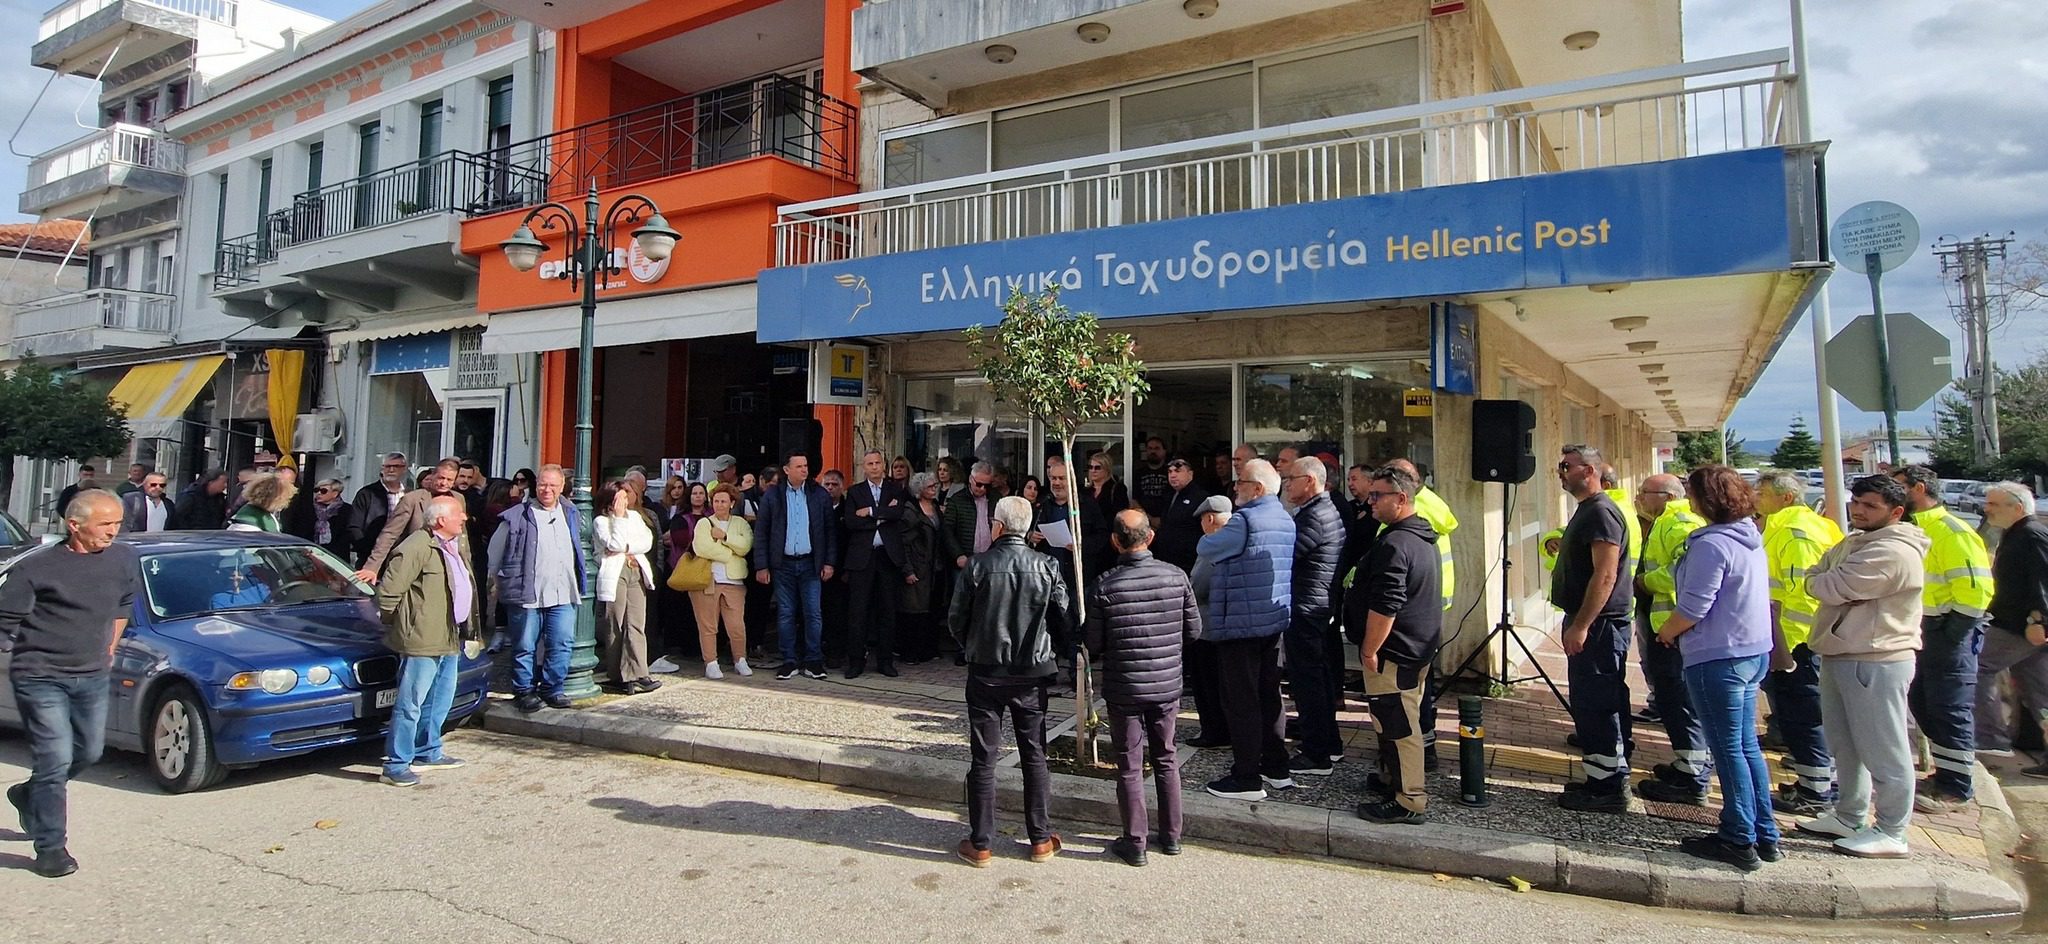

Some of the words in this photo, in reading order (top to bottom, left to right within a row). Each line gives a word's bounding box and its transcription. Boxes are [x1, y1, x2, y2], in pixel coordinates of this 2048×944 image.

[921, 256, 1082, 307] Ελληνικά
[1095, 229, 1367, 296] Ταχυδρομεία
[1386, 225, 1523, 262] Hellenic
[1535, 218, 1611, 249] Post
